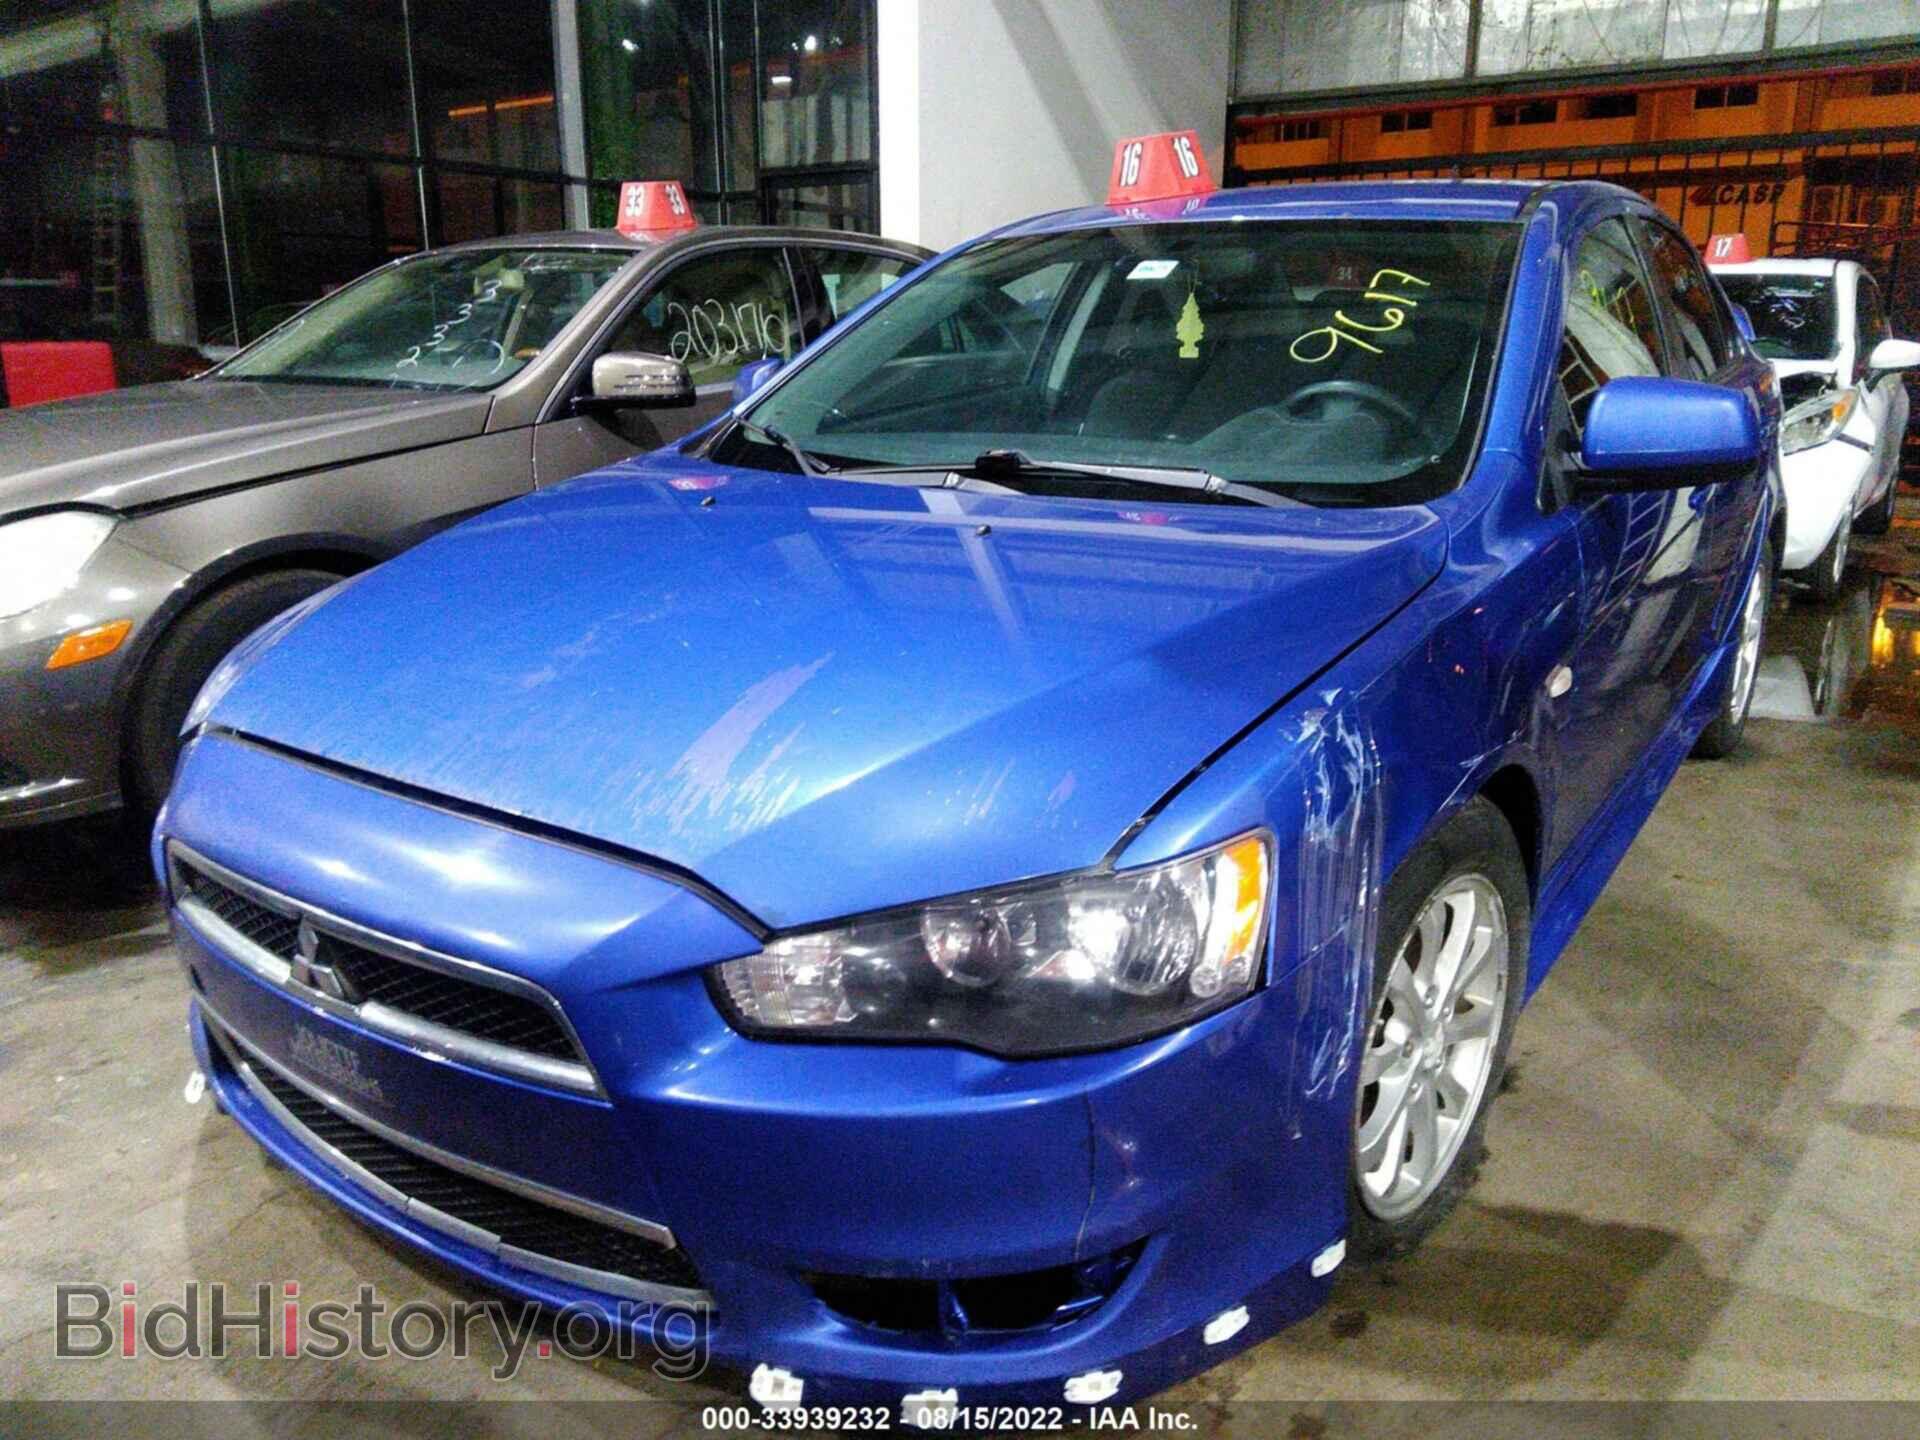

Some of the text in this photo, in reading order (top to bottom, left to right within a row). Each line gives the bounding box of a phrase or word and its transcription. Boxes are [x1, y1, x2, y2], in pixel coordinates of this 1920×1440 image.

[1119, 142, 1144, 187] 16
[1172, 136, 1200, 178] 16
[623, 184, 647, 217] 33
[1713, 236, 1734, 257] 17
[667, 298, 787, 364] 203176
